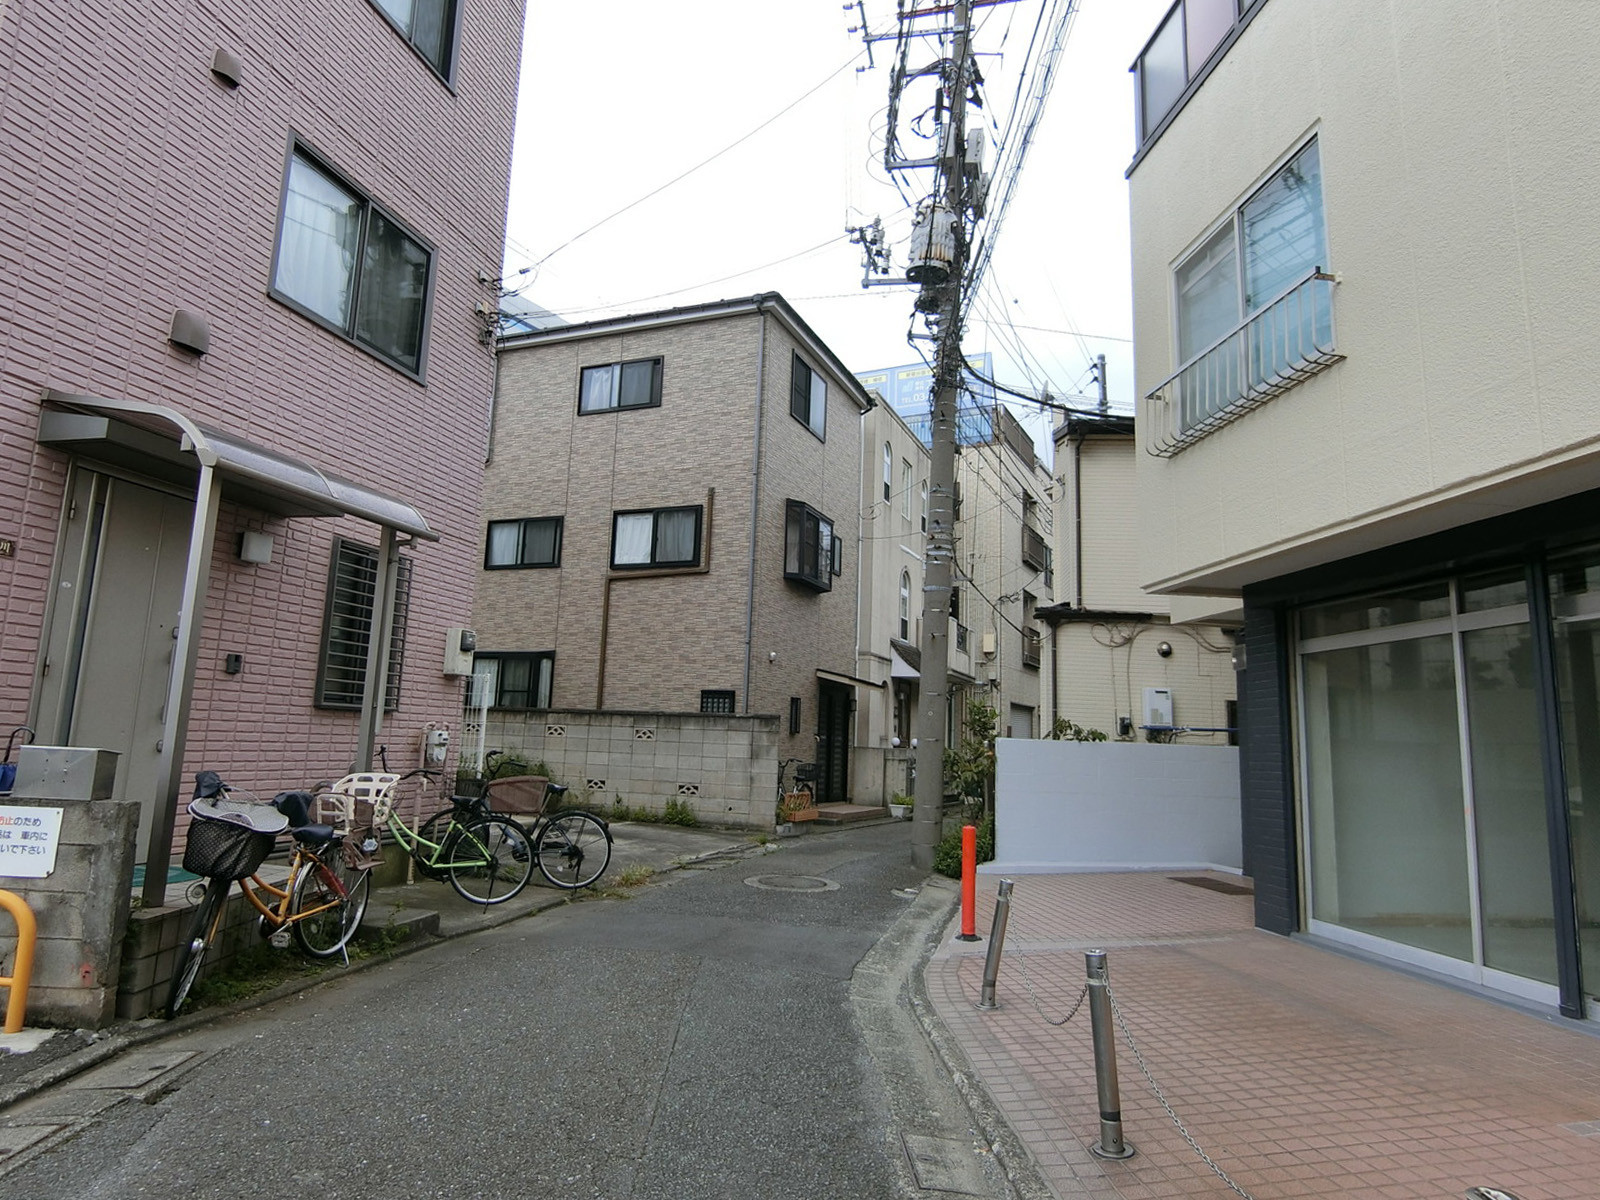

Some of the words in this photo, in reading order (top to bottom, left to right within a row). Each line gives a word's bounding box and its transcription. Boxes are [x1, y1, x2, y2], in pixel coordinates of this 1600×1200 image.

[0, 830, 12, 839] は
[21, 830, 48, 841] 車内に
[0, 844, 46, 855] いで下さい
